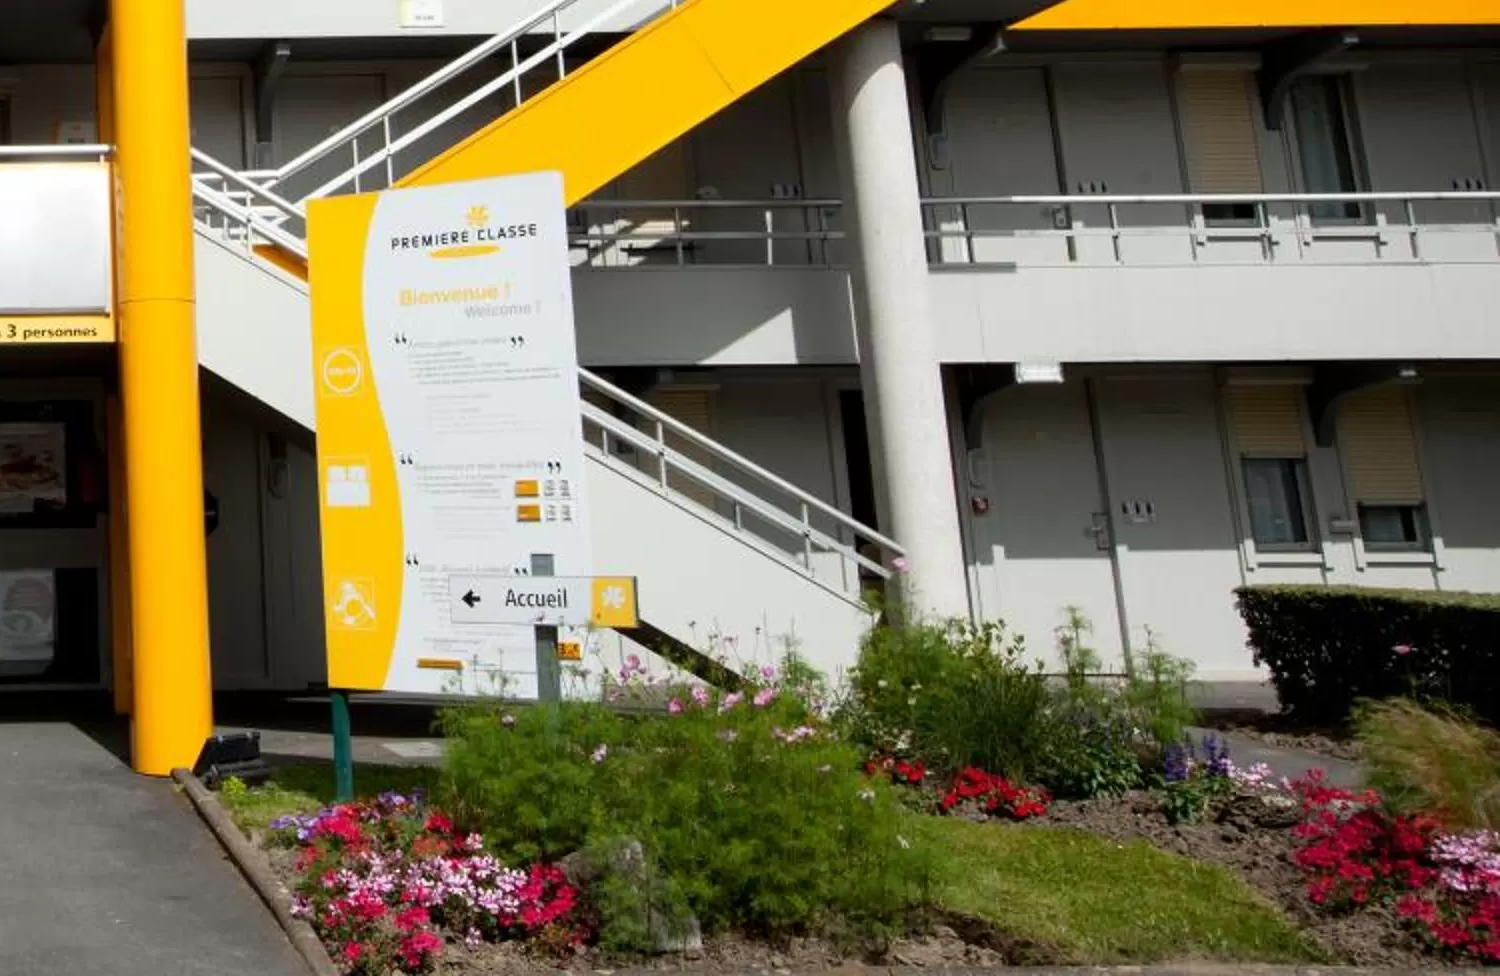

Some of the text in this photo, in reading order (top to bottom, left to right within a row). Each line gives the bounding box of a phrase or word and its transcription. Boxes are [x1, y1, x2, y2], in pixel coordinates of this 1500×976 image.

[391, 224, 537, 250] PREMIERE CLASSE
[6, 324, 17, 338] 3
[22, 324, 98, 339] personnes
[505, 587, 567, 608] Accueil
